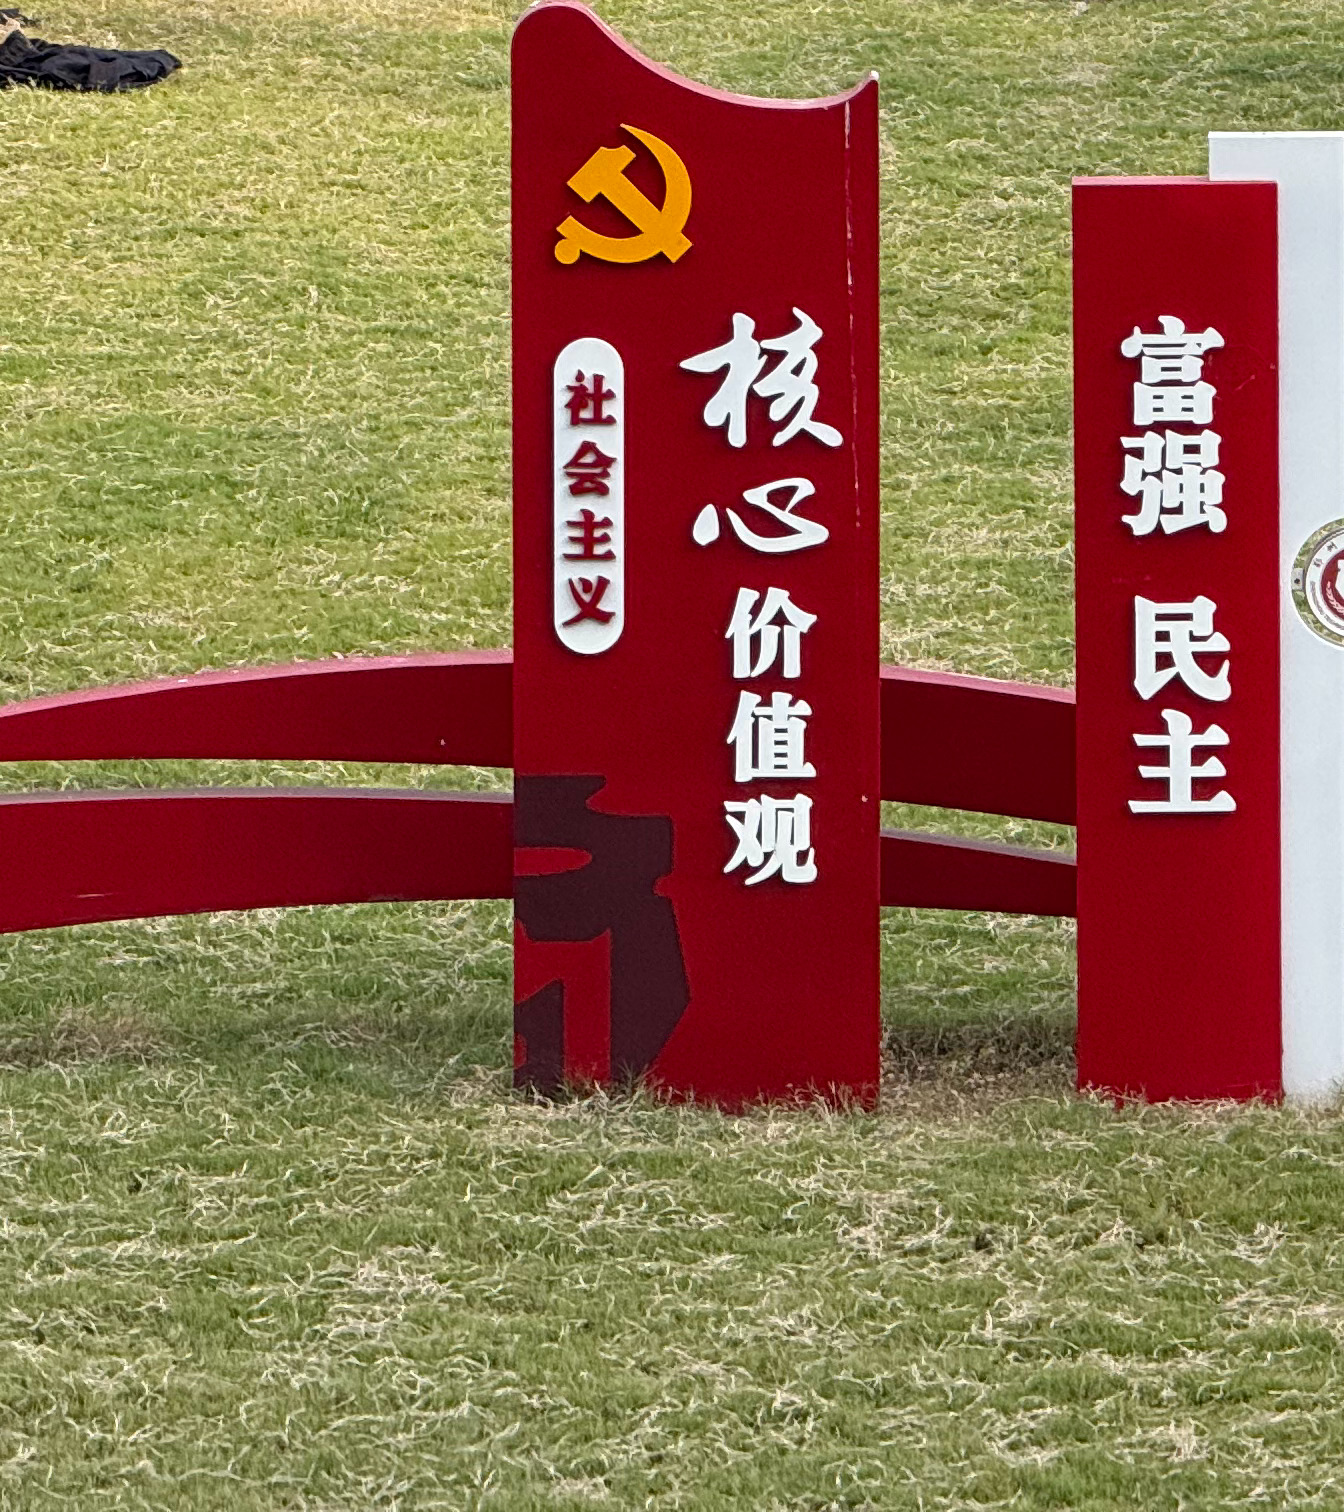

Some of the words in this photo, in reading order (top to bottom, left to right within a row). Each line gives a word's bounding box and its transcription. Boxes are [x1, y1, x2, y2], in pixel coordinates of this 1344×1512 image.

[563, 368, 617, 629] 社会主义
[1119, 315, 1228, 536] 富强
[679, 307, 842, 887] 核心价值观
[1127, 595, 1237, 814] 民主
